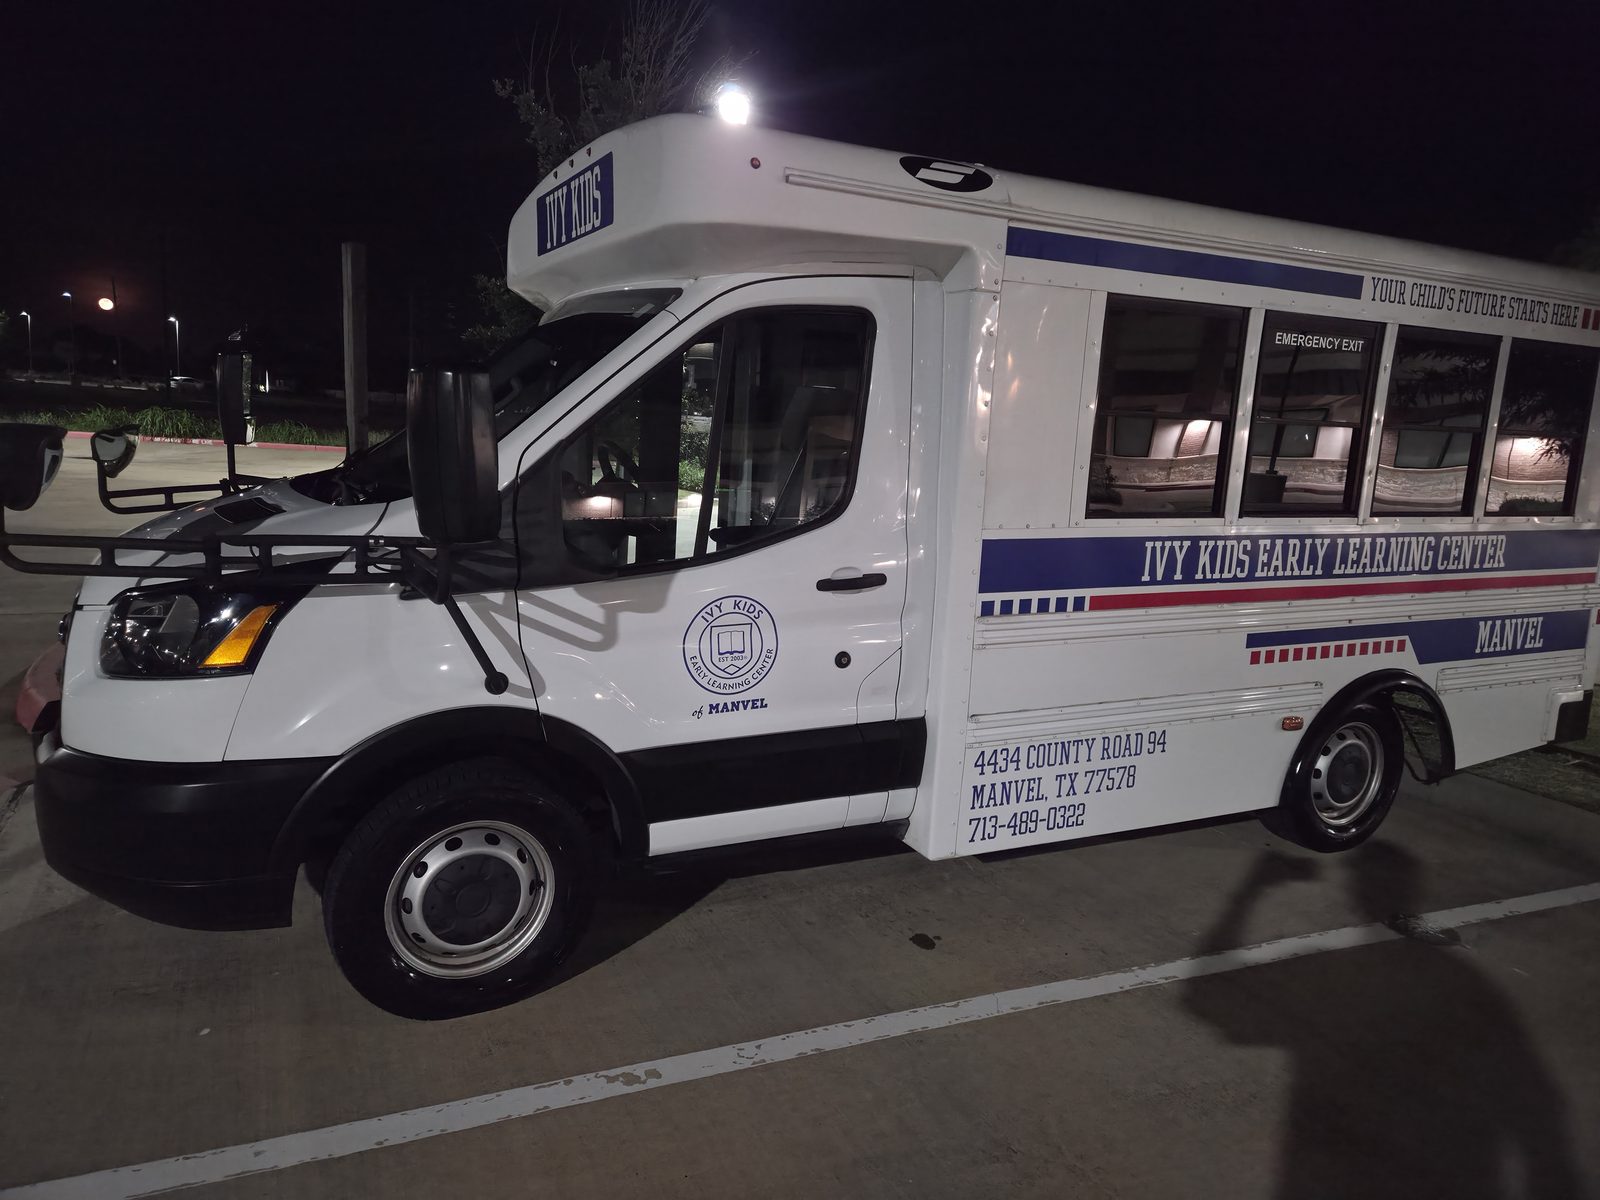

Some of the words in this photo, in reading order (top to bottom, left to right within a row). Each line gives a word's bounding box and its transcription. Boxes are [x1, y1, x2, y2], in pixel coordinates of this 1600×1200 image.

[545, 185, 568, 250] IVY
[570, 165, 602, 238] KIDS
[1371, 276, 1407, 305] YOUR
[1410, 282, 1456, 312] CHILD'S
[1456, 289, 1505, 318] FUTURE
[1507, 297, 1549, 324] STARTS
[1550, 303, 1580, 328] HERE
[1275, 332, 1341, 350] EMERGENCY
[1341, 338, 1365, 352] EXIT
[1141, 540, 1191, 582] IVY
[1194, 539, 1252, 580] KIDS
[1254, 538, 1331, 577] EARLY
[1332, 536, 1435, 575] LEARNING
[1437, 535, 1507, 571] CENTER
[701, 602, 723, 623] IVY
[733, 599, 764, 620] KIDS
[1475, 616, 1544, 654] MANVEL
[690, 655, 708, 680] EARLY
[707, 677, 751, 691] LEARNING
[751, 648, 774, 680] CENTER
[691, 705, 704, 719] of
[708, 698, 768, 715] MANVEL
[974, 746, 1021, 776] 4434
[1026, 737, 1096, 769] COUNTY
[1100, 732, 1144, 761] ROAD
[1147, 729, 1167, 755] 94
[970, 776, 1049, 810] MANVEL,
[1055, 772, 1080, 798] TX
[1083, 764, 1137, 795] 77578
[968, 802, 1086, 843] 713-489-0322
